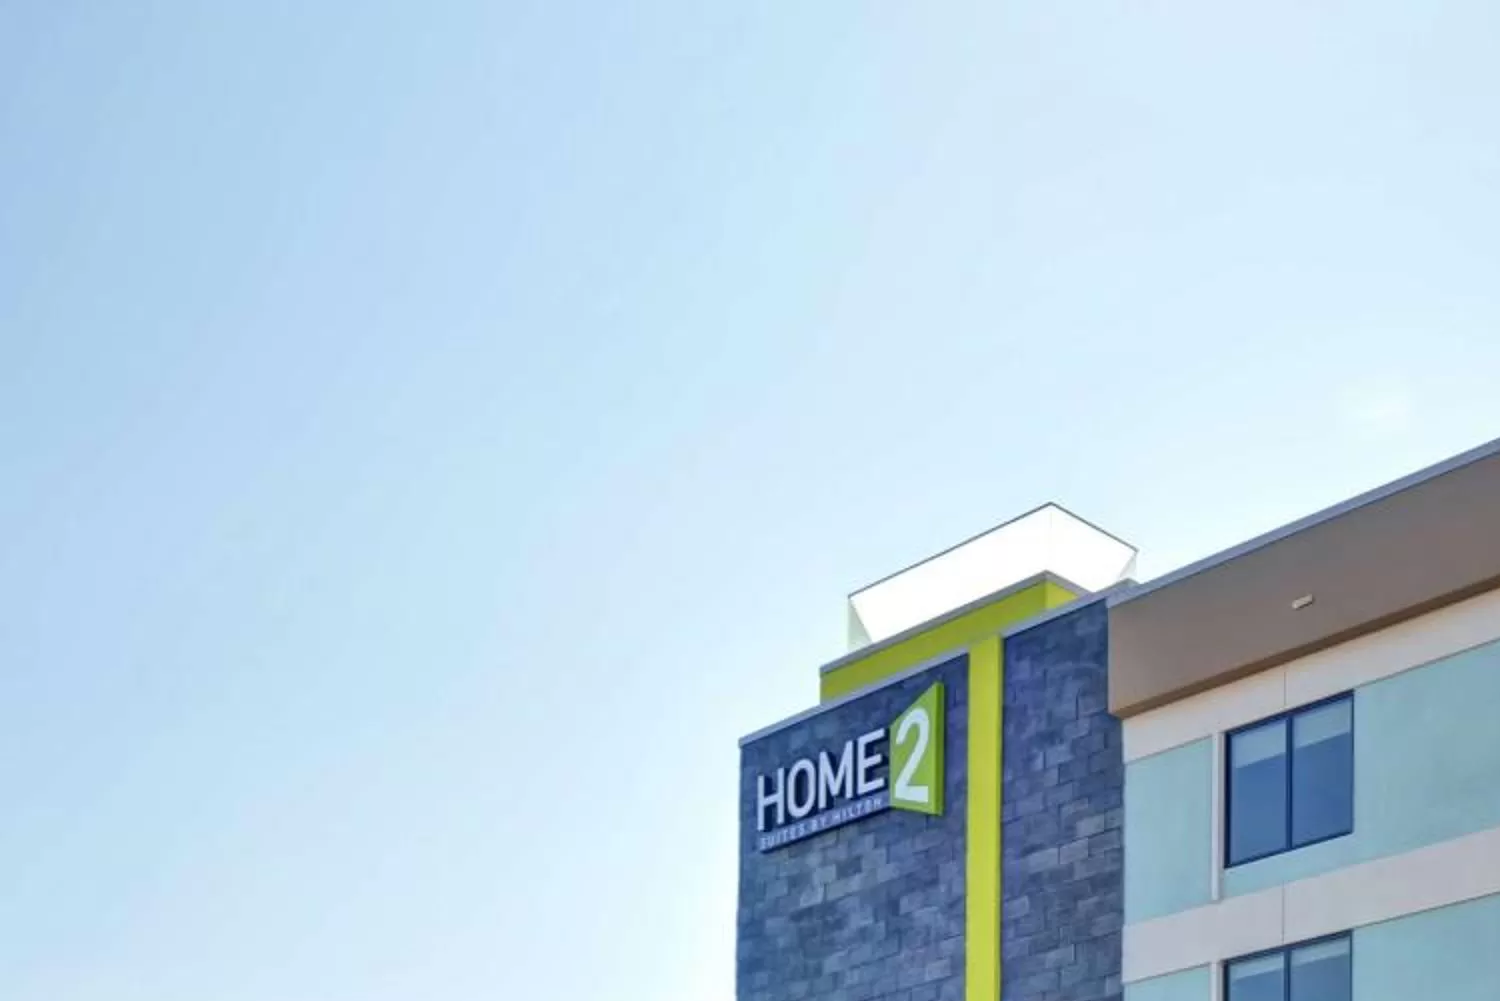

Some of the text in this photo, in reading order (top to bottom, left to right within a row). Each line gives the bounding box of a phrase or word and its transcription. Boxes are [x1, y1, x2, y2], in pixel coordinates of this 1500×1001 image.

[757, 707, 929, 831] HOME 2
[759, 822, 805, 850] SUITES
[833, 797, 882, 824] HILTON
